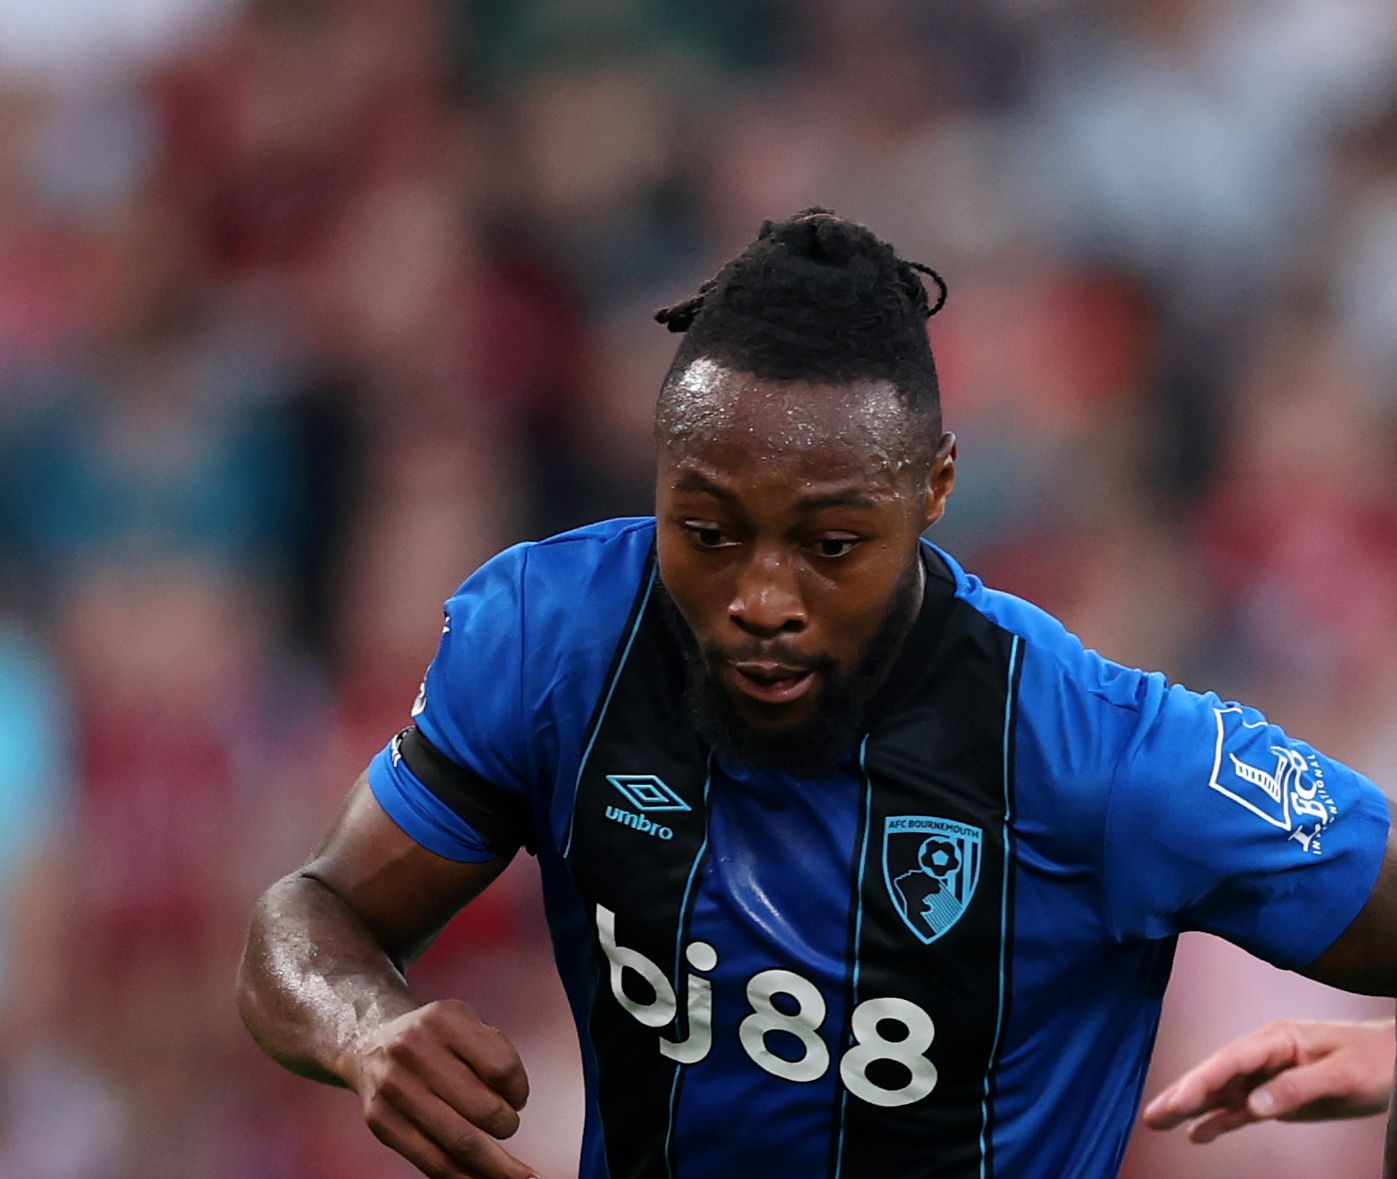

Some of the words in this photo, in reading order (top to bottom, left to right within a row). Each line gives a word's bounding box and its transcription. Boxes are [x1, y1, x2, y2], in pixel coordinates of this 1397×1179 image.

[605, 805, 674, 841] umbro
[888, 820, 906, 829] AFC
[908, 820, 980, 838] BOURNEMOUTH
[596, 902, 938, 1107] bj88
